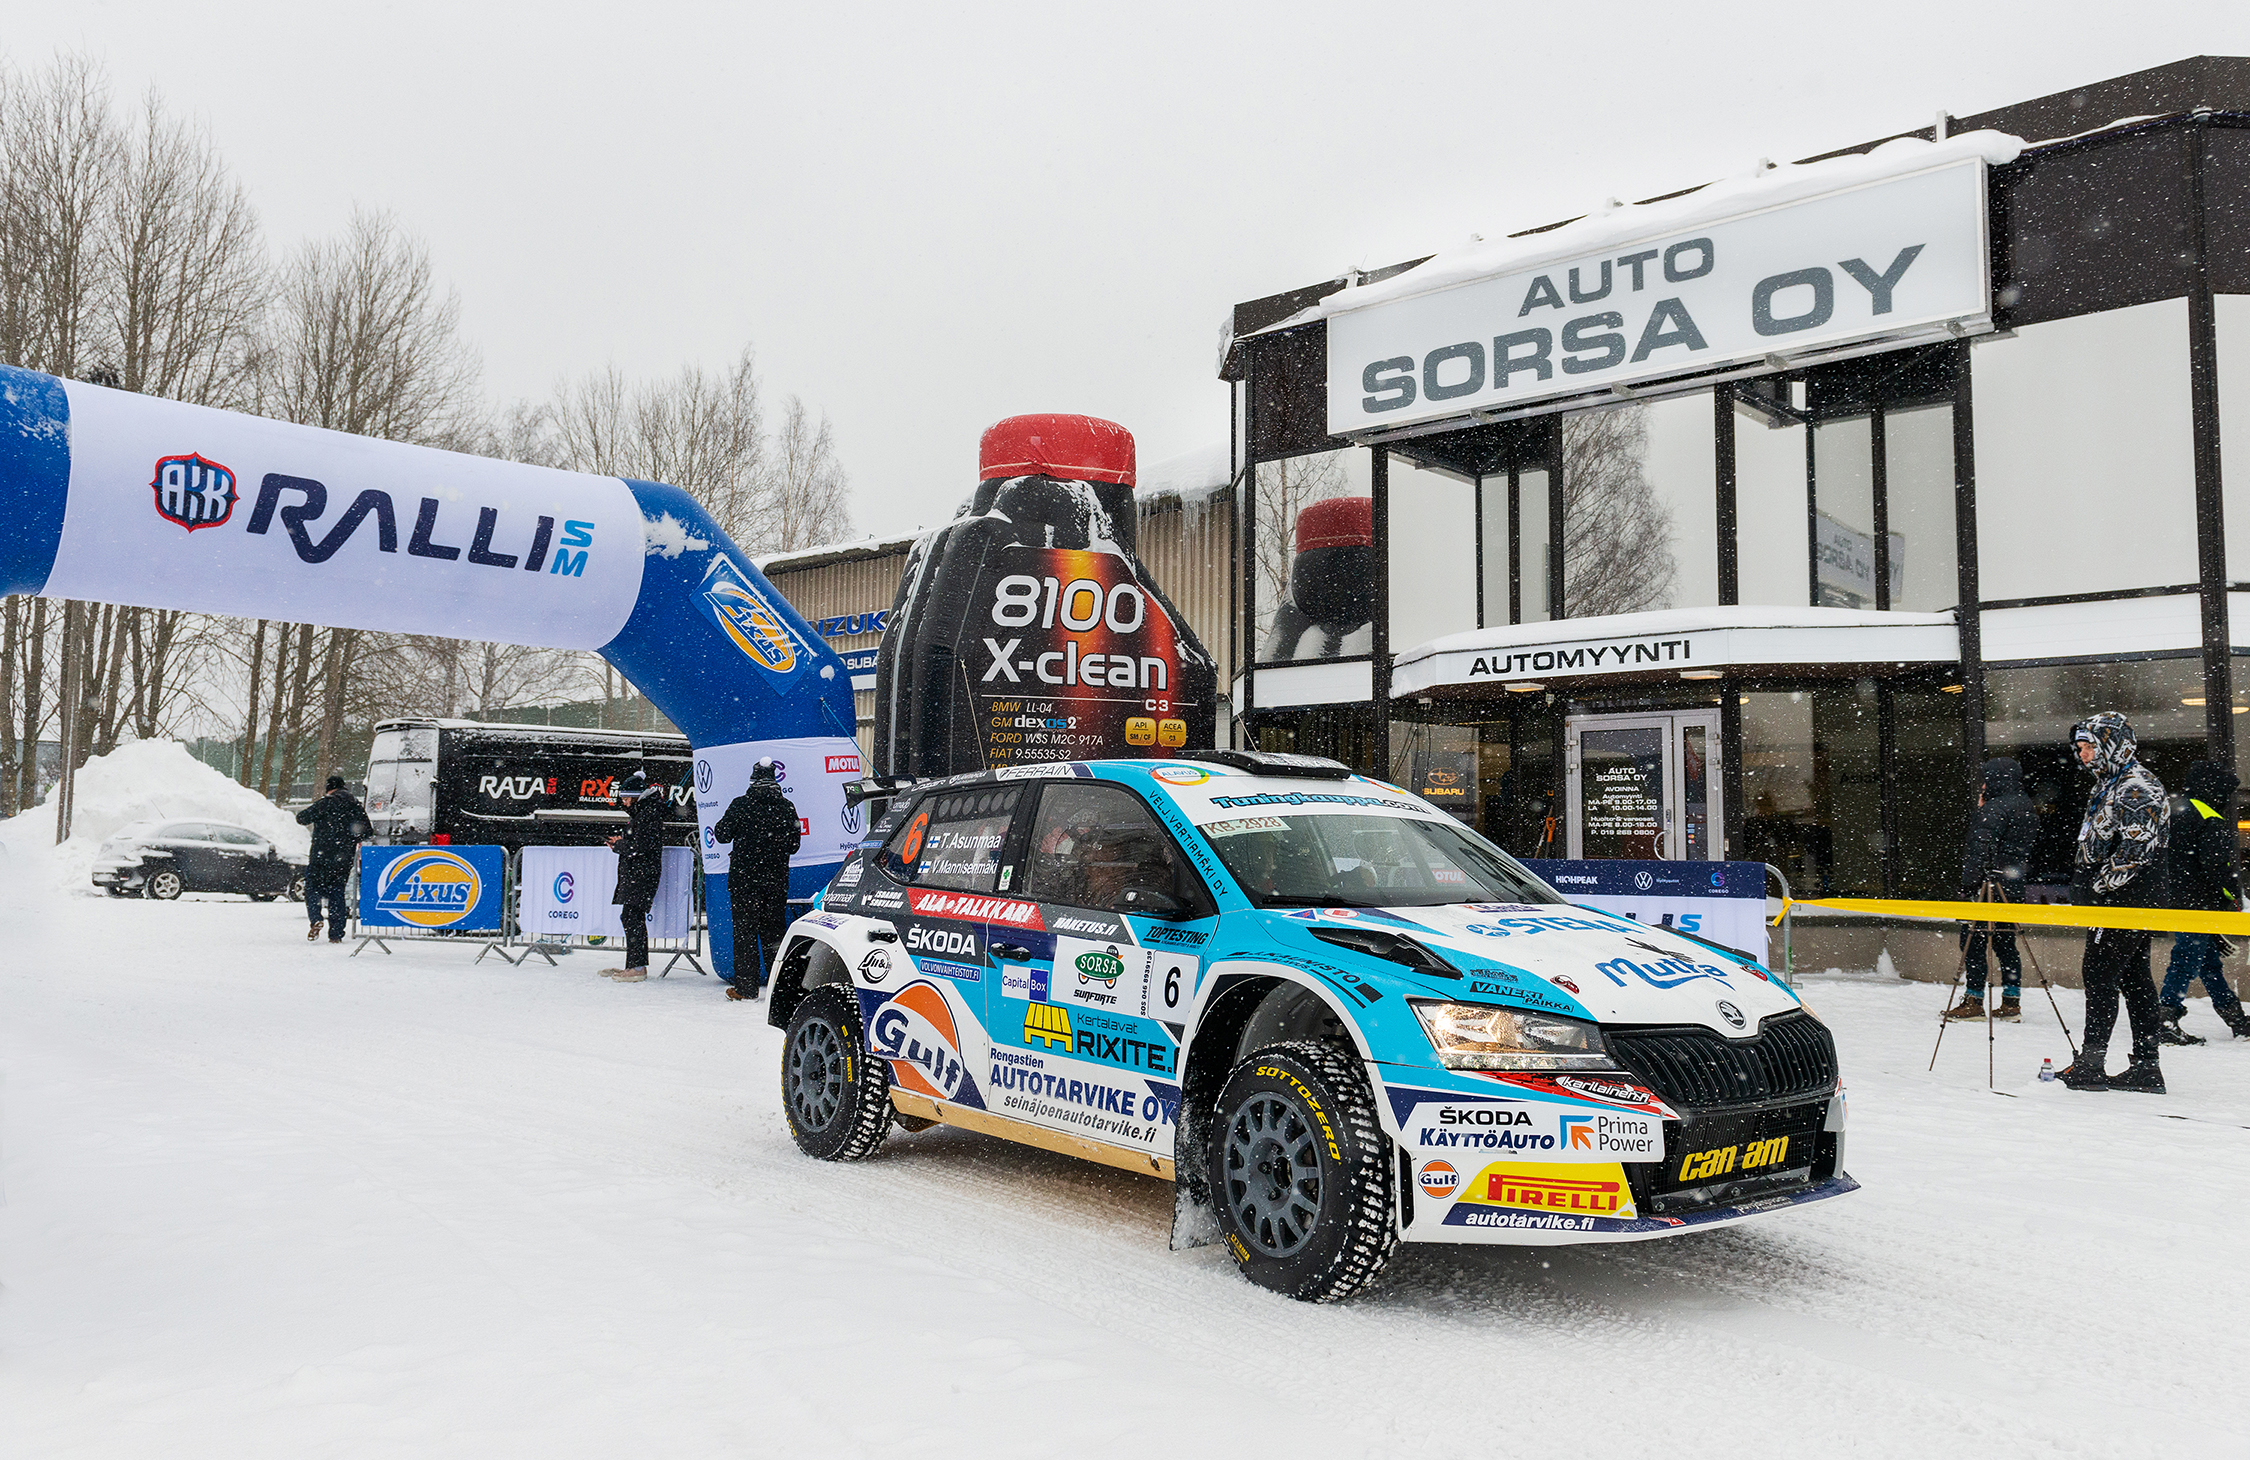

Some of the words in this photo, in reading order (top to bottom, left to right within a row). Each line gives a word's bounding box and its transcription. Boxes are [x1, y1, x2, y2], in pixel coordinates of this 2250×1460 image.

[1517, 236, 1714, 318] AUTO
[1360, 296, 1708, 415] SORSA
[1752, 242, 1926, 338] OY
[247, 472, 555, 571] RALLI
[991, 574, 1145, 633] 8100
[703, 592, 787, 668] Fixus
[981, 637, 1168, 691] X-clean
[1470, 639, 1691, 677] AUTOMYYNTI
[991, 701, 1021, 713] BMW
[1026, 702, 1052, 713] LL-04
[1145, 698, 1169, 712] C3
[991, 716, 1013, 728] GM
[1014, 714, 1077, 730] dexos2
[1135, 721, 1147, 729] API
[990, 732, 1022, 744] FORD
[1025, 733, 1048, 744] WSS
[1050, 734, 1076, 745] M2C
[1079, 735, 1104, 746] 917A
[989, 748, 1013, 759] FIAT
[1015, 748, 1072, 760] 9.55535-S2
[827, 757, 860, 772] MOTUL
[1608, 767, 1636, 775] AUTO
[479, 775, 546, 800] RATA
[1422, 787, 1465, 796] SUBARU
[1212, 792, 1432, 815] Tuningkauppa.com
[902, 812, 928, 865] 6
[941, 832, 1002, 850] T.Asunmaa
[931, 859, 998, 875] V.Mannisenmäki
[377, 868, 473, 911] Fixus
[1213, 880, 1229, 898] OY
[1555, 875, 1599, 885] HIGHPEAK
[548, 910, 579, 921] COREGO
[906, 923, 976, 957] ŠKODA
[1145, 925, 1209, 945] TOPTESTING
[1080, 956, 1118, 975] SORSA
[1002, 973, 1029, 990] Capital
[1031, 979, 1048, 992] Box
[1164, 966, 1182, 1009] 6
[1524, 997, 1572, 1011] PAIKKA
[1077, 1013, 1138, 1035] Kertalavat
[874, 1008, 963, 1094] Gulf
[990, 1047, 1044, 1070] Rengastien
[989, 1065, 1136, 1117] AUTOTARVIKE
[1141, 1093, 1177, 1126] OY
[1003, 1093, 1157, 1143] seinäjoenautotarvike.fi
[1256, 1065, 1342, 1162] SOTTOZERO
[1439, 1105, 1533, 1127] ŠKODA
[1598, 1115, 1648, 1135] Prima
[1599, 1133, 1654, 1153] Power
[1420, 1172, 1458, 1186] Gulf
[1487, 1173, 1621, 1211] PIRELLI
[1465, 1211, 1596, 1231] autotarvike.fi
